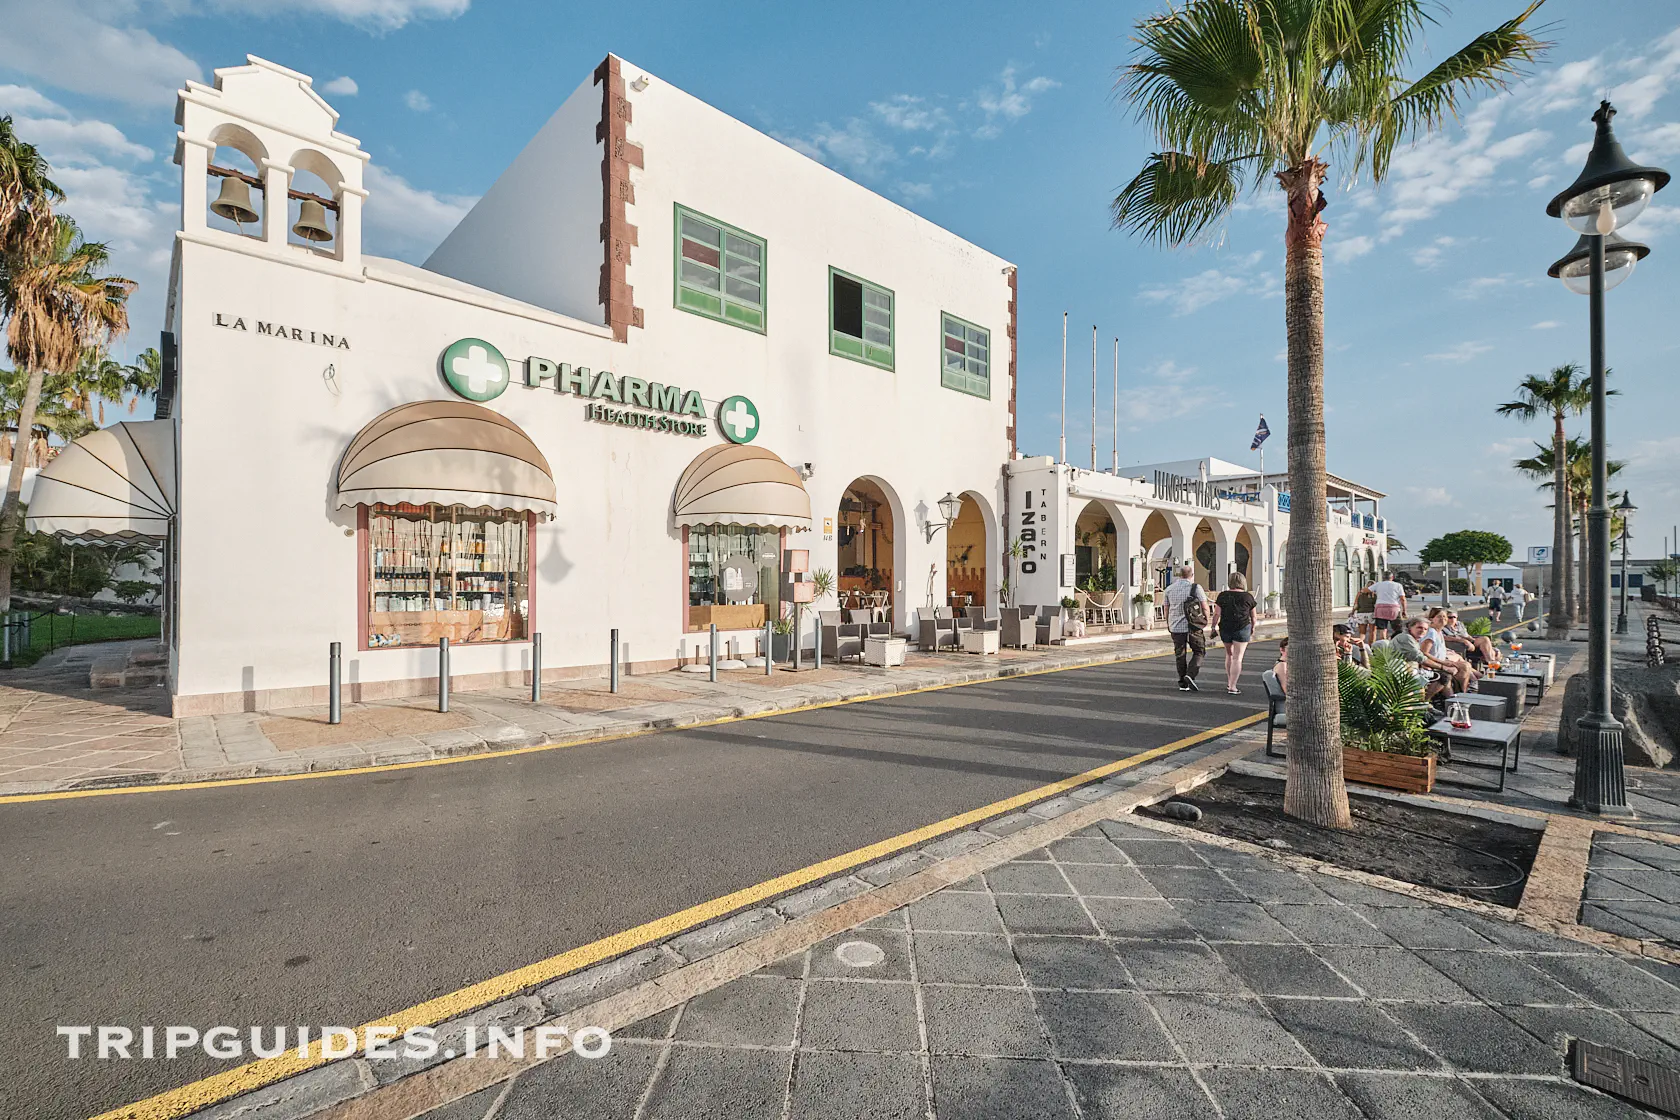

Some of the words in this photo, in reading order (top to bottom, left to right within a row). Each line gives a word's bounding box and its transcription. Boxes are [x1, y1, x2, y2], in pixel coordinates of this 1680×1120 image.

[215, 313, 247, 331] LA
[257, 321, 350, 349] MARINA
[526, 355, 707, 418] PHARMA
[588, 403, 658, 431] HEALTH
[660, 414, 707, 437] STORE
[1152, 469, 1192, 505] JUNGLE
